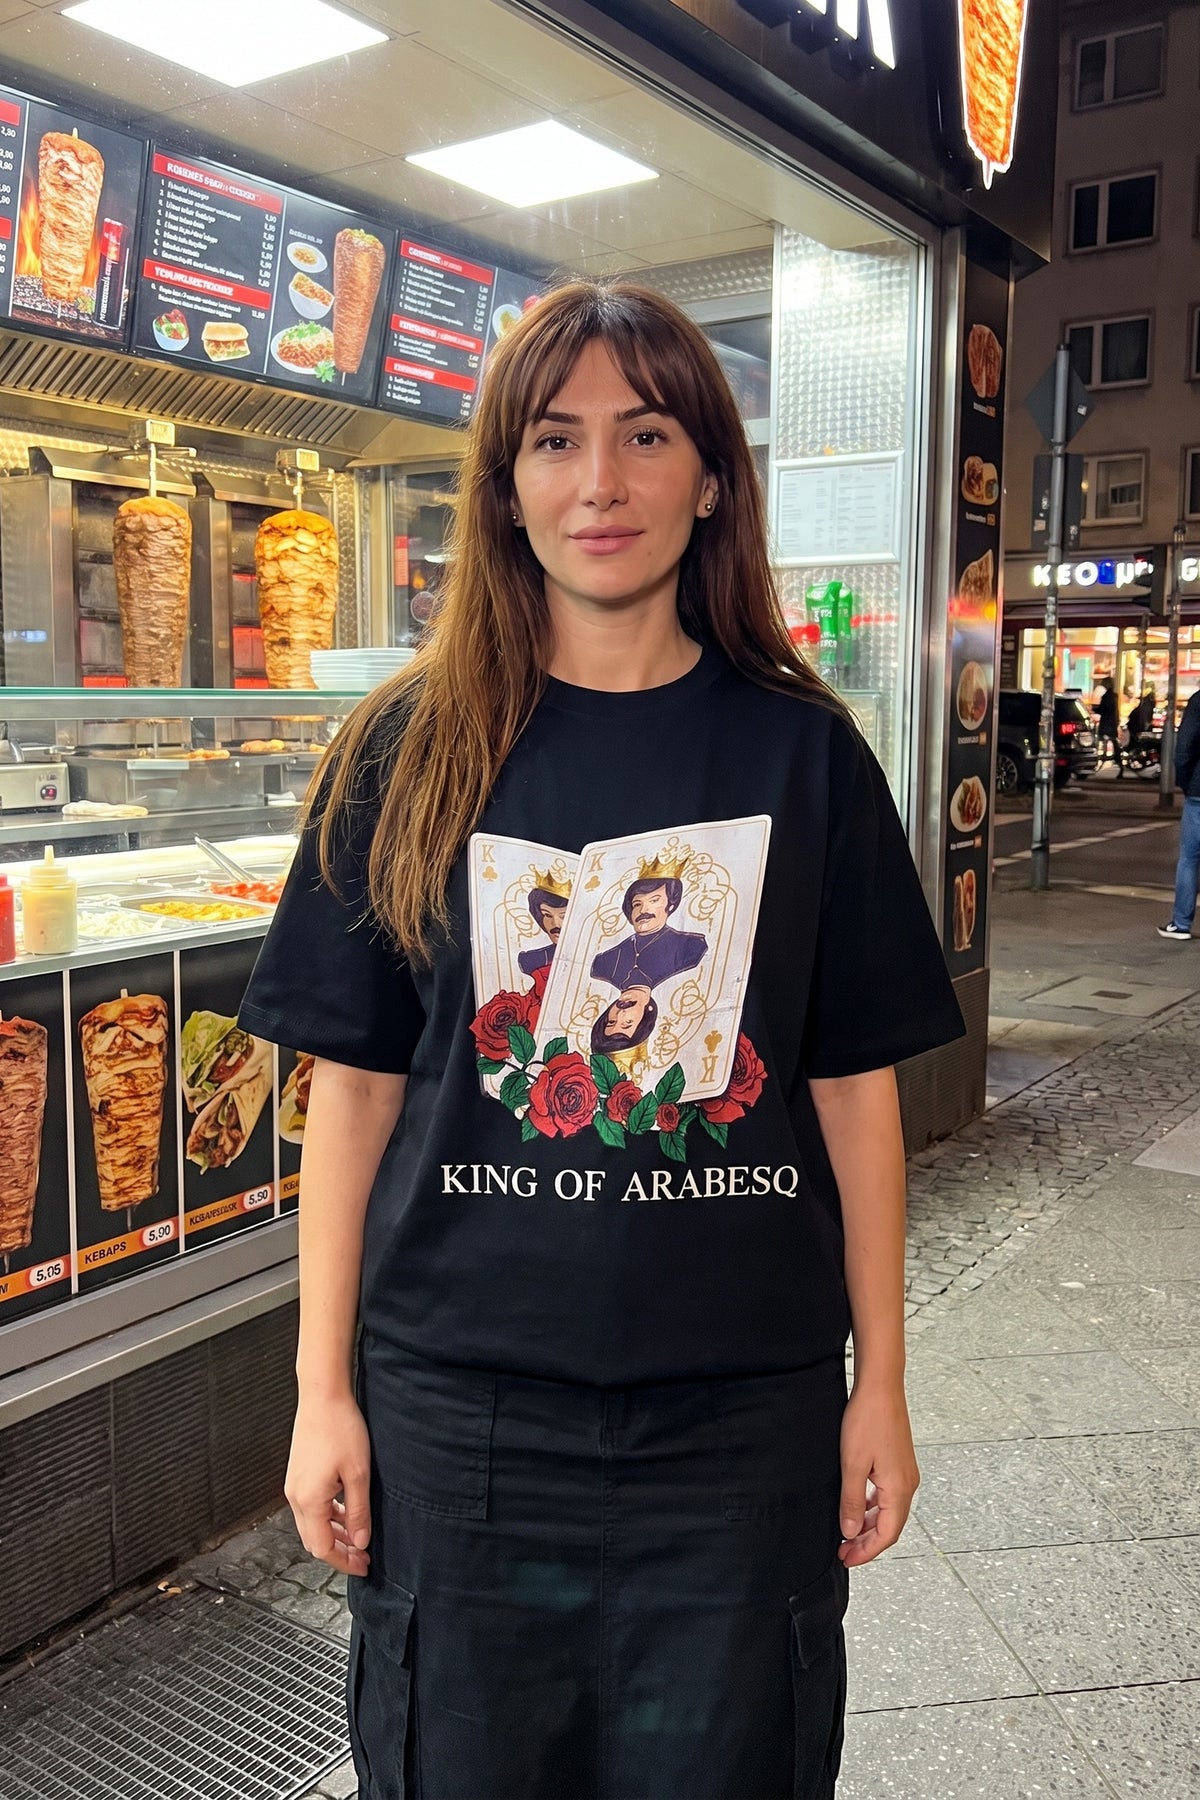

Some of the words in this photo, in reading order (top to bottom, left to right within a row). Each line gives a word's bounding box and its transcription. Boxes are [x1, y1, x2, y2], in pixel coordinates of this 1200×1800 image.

[1181, 557, 1200, 582] G
[481, 843, 496, 863] K
[588, 851, 608, 872] K
[441, 1163, 538, 1198] KING
[554, 1168, 606, 1201] OF
[620, 1165, 799, 1202] ARABESQ
[85, 1241, 127, 1265] KEBAPS
